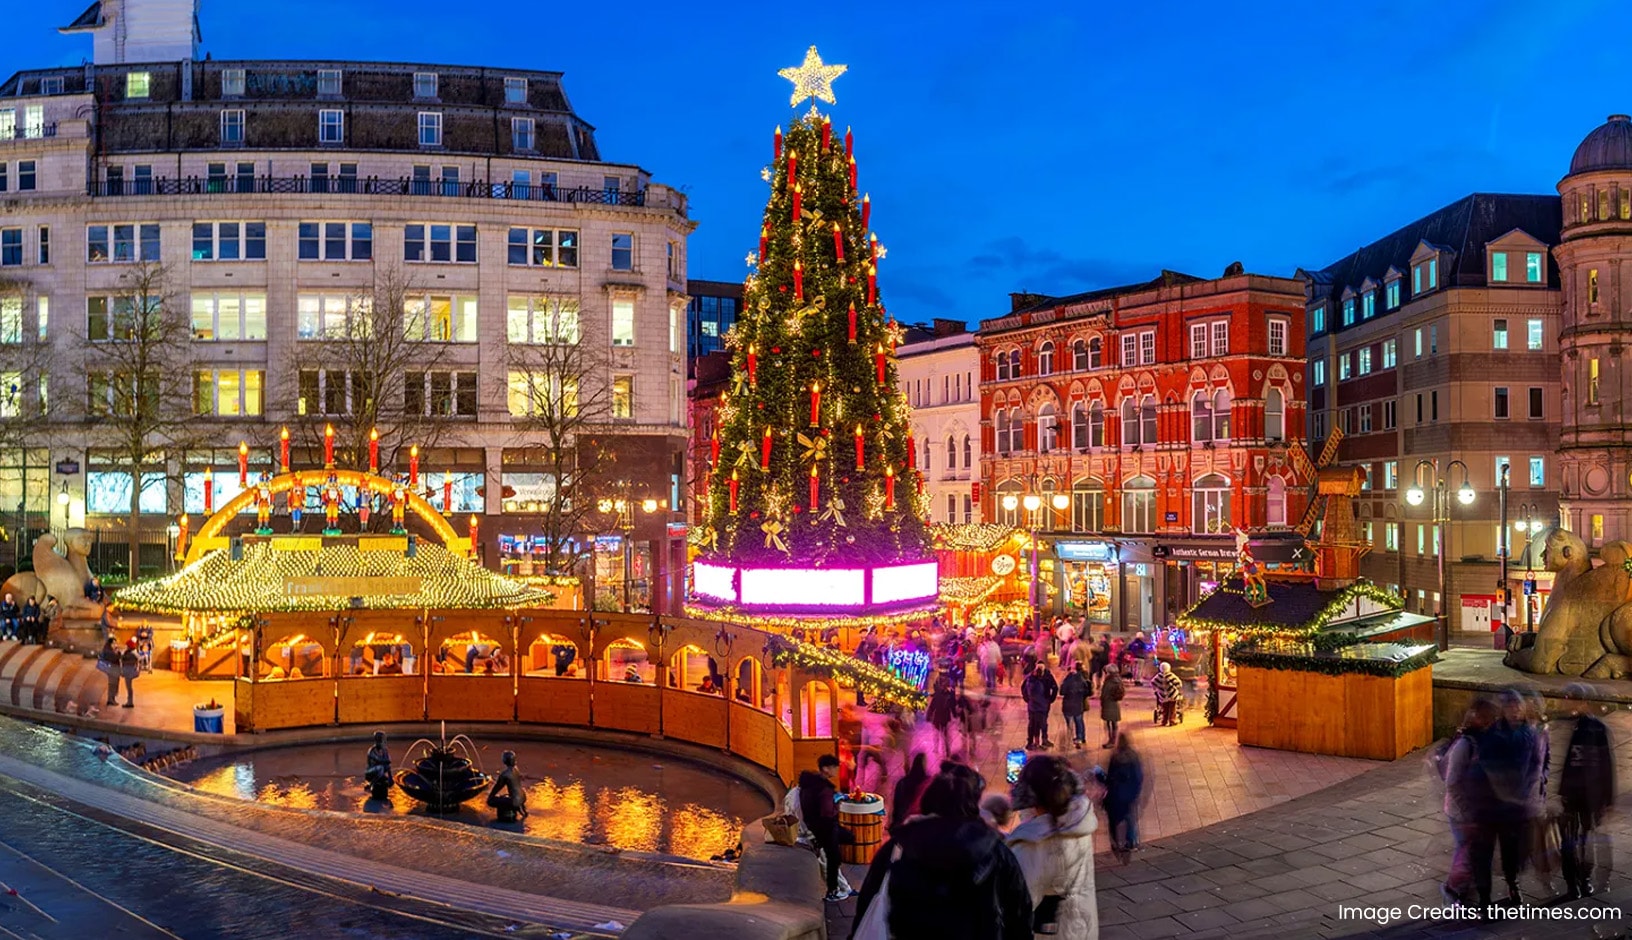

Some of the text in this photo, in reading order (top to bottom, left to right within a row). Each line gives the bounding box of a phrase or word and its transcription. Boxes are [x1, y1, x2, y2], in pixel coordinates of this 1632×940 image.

[1172, 547, 1198, 557] Authentic
[1198, 548, 1220, 557] German
[1135, 562, 1146, 577] 81
